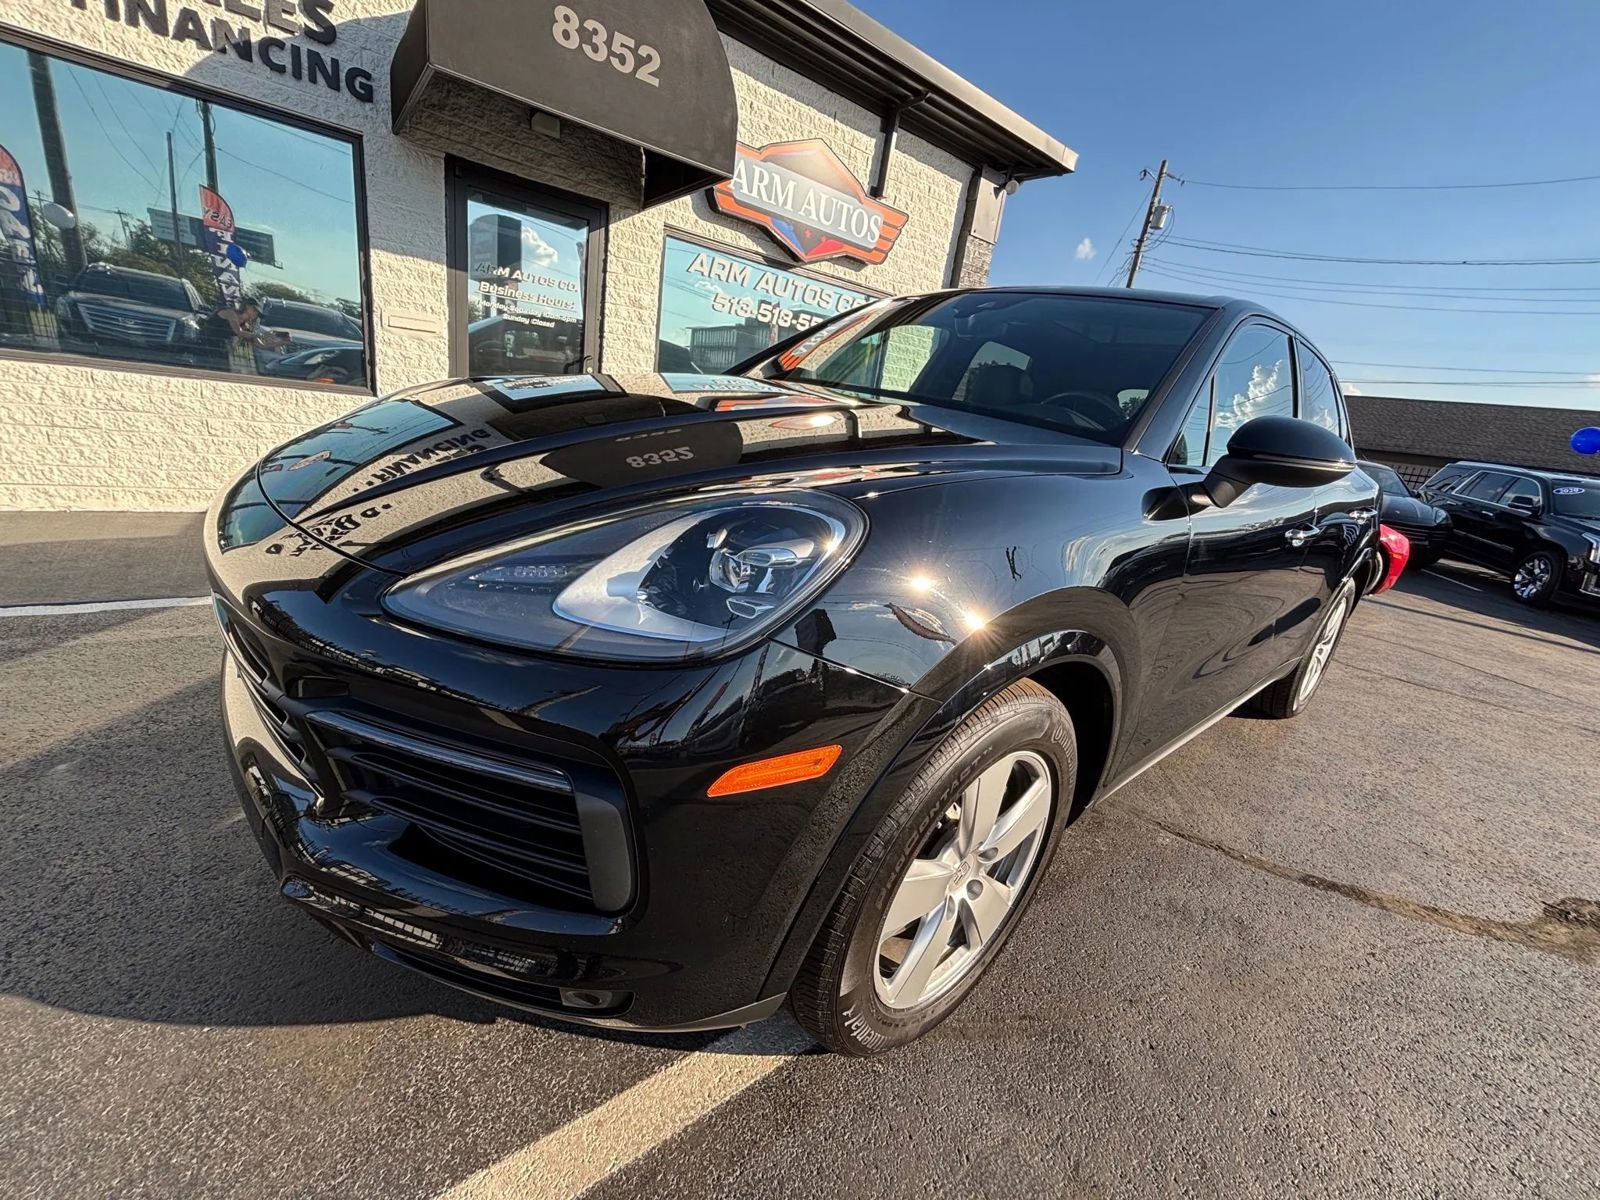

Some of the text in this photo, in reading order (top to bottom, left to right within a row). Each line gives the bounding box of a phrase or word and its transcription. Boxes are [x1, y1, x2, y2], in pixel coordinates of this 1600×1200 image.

[70, 0, 374, 103] INANCING
[552, 5, 661, 88] 8352
[729, 159, 881, 244] ARM AUTOS
[475, 262, 511, 278] ARM
[511, 270, 557, 287] AUTOS
[479, 281, 576, 310] Business Hours
[687, 252, 752, 287] ARM
[753, 271, 834, 309] AUTOS
[503, 313, 555, 329] Sunday Closed
